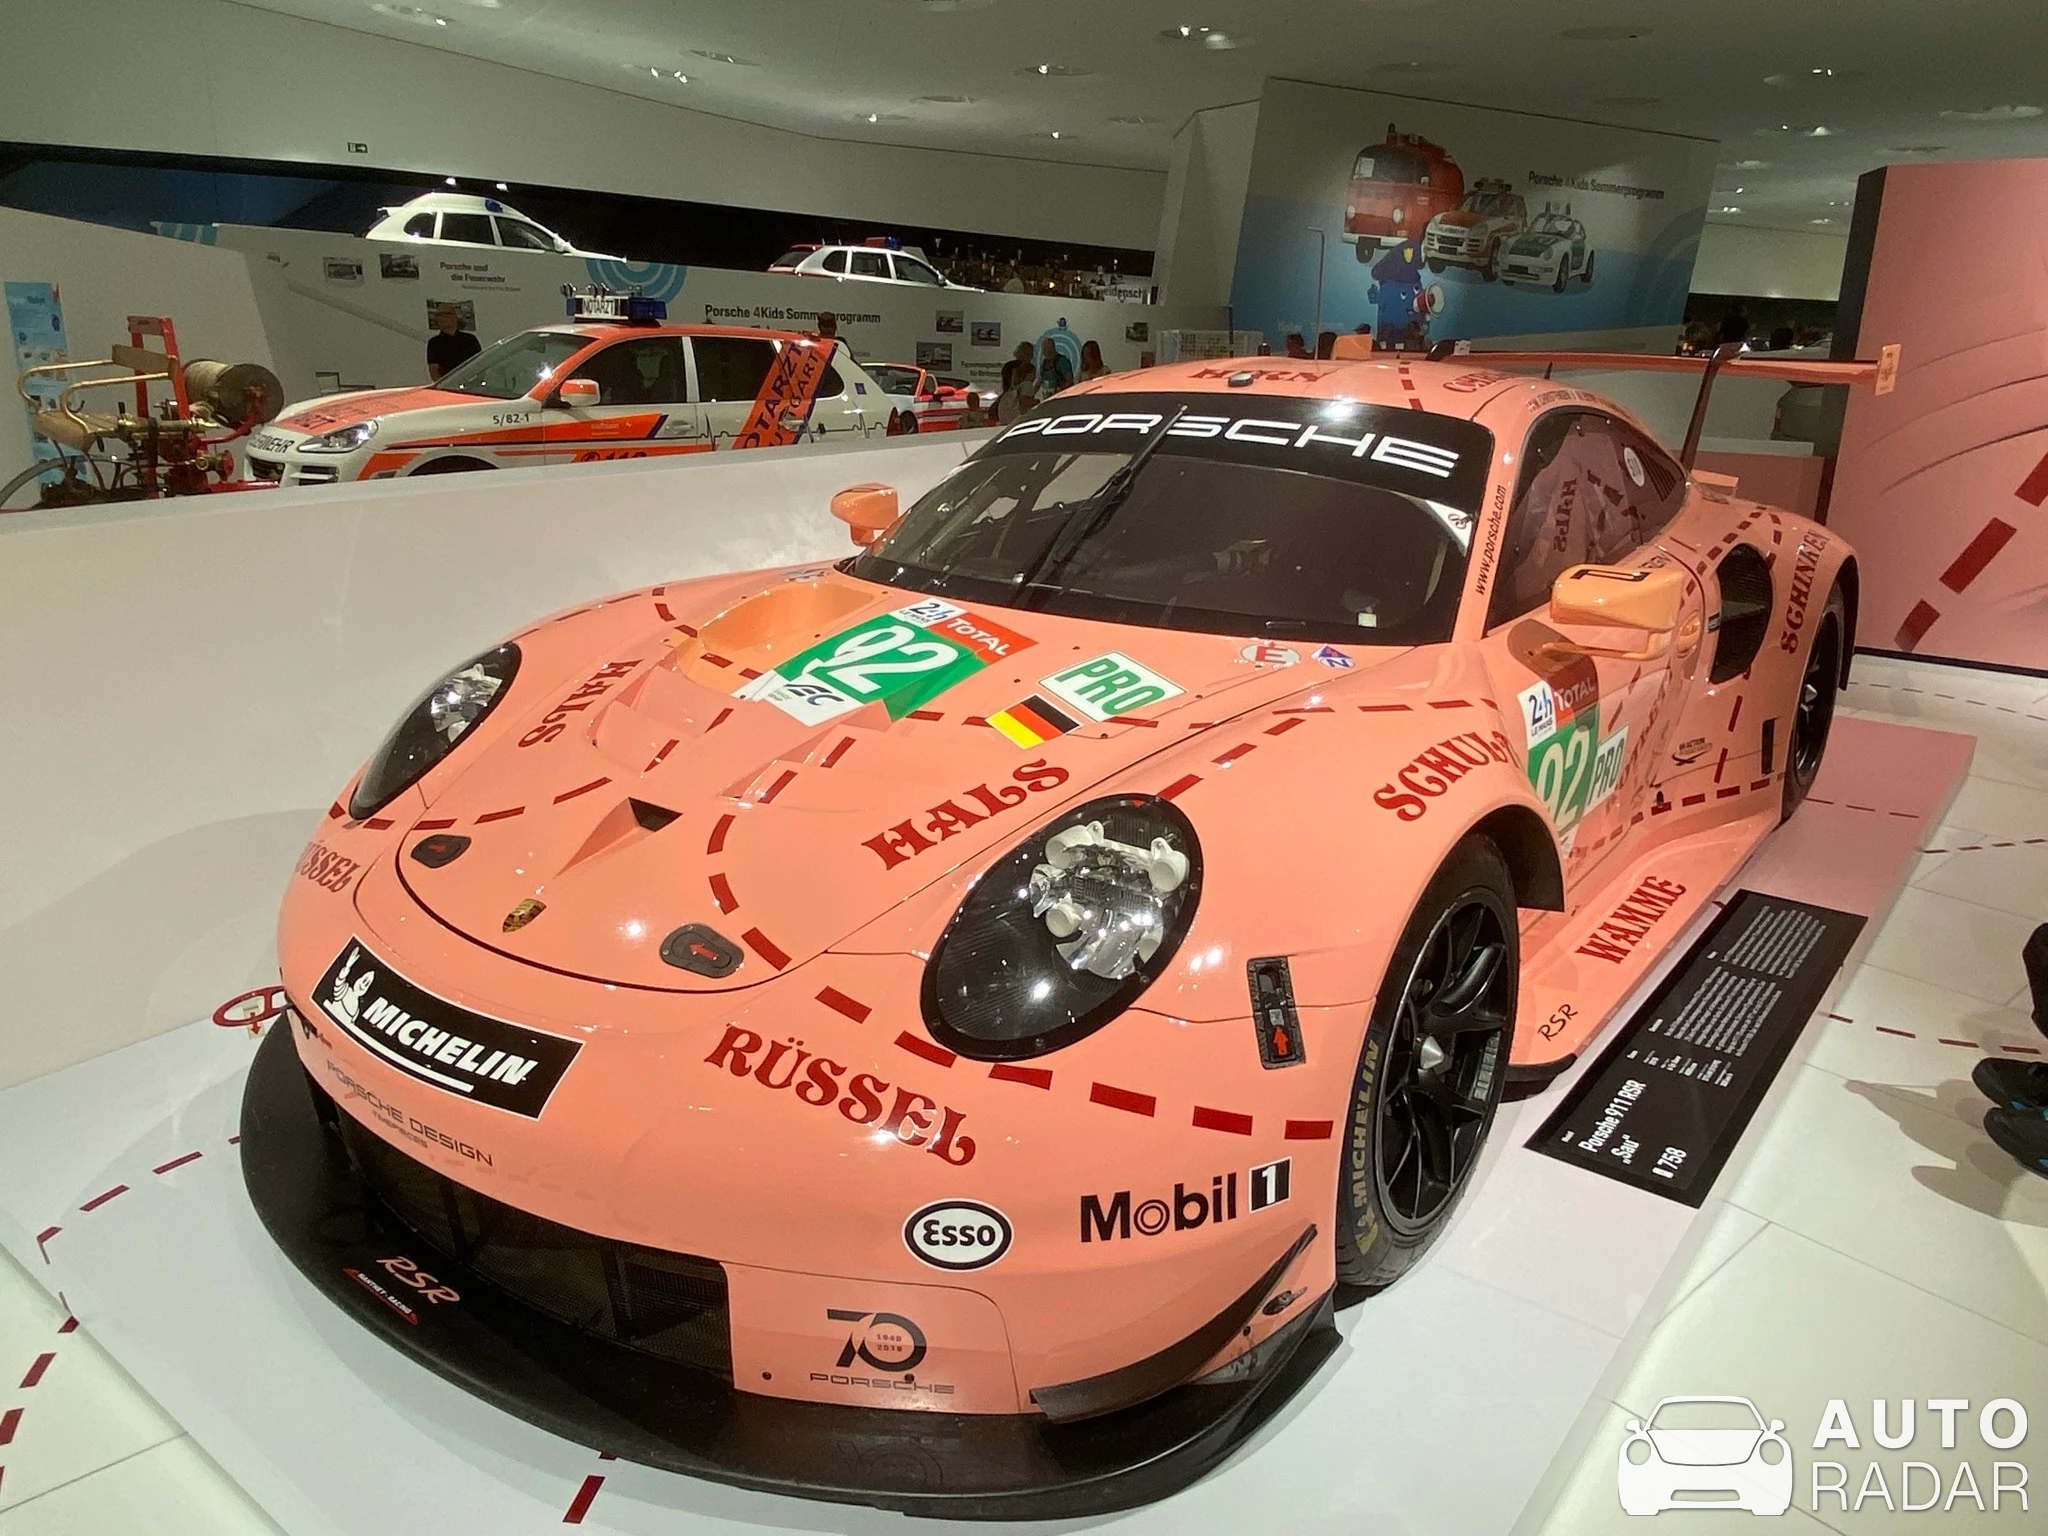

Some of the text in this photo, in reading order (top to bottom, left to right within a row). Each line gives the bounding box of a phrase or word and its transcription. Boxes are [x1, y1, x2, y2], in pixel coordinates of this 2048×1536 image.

[705, 305, 881, 325] Porsche 4Kids Sommrogramm
[493, 413, 530, 427] 5/82-1
[997, 413, 1460, 478] PORSCHE
[1475, 485, 1507, 596] www.porsche.com
[946, 618, 1010, 656] TOTAL
[1056, 657, 1166, 715] PRO
[1528, 684, 1553, 726] 24h
[1554, 676, 1596, 712] TOTAL
[1588, 738, 1625, 806] PRO
[861, 758, 1070, 871] HALS
[1574, 876, 1688, 965] WAMME
[362, 996, 539, 1086] MICHELIN
[1537, 1003, 1579, 1042] RSR
[326, 1059, 404, 1125] PORSCHE
[409, 1116, 494, 1168] DESIGN
[703, 1022, 976, 1166] RÜSSEL
[1351, 1038, 1379, 1208] MICHELIN
[1578, 1079, 1647, 1153] Porsche 911 RSR
[1657, 1146, 1687, 1170] 758
[923, 1219, 996, 1248] Esso
[1081, 1164, 1279, 1243] Mobil 1
[376, 1255, 461, 1304] RSR
[826, 1308, 928, 1373] 70
[810, 1372, 955, 1395] PORSCHE
